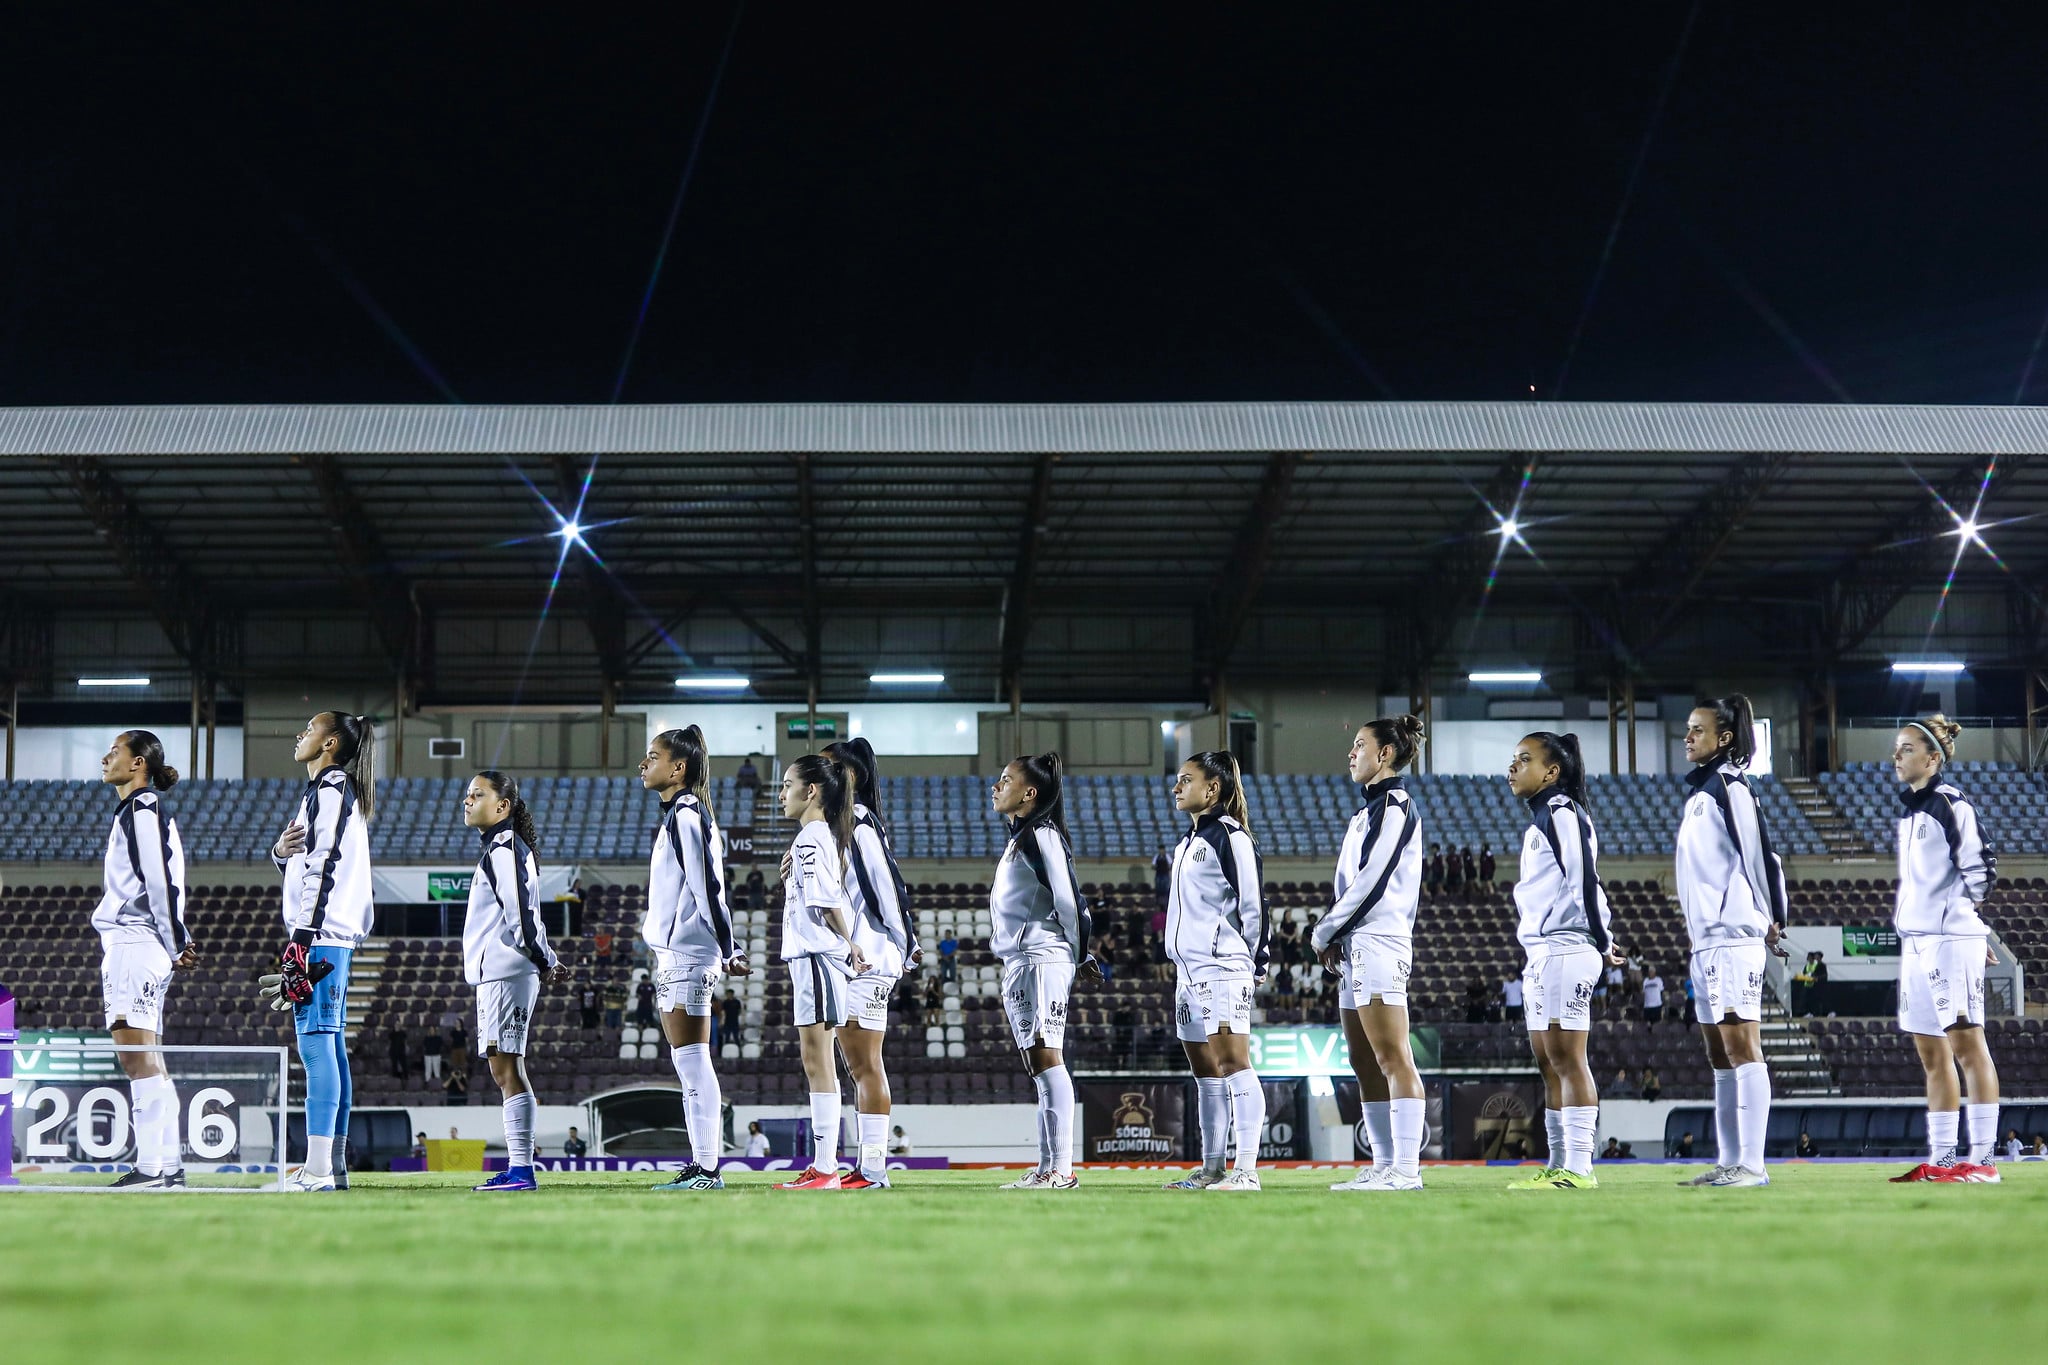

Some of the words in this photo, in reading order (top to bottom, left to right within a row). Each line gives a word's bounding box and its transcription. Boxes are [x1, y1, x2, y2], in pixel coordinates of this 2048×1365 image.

[730, 838, 753, 851] VIS
[1845, 932, 1897, 945] REVEE
[1115, 1125, 1152, 1139] SÓCIO
[1096, 1139, 1170, 1154] LOCOMOTIVA
